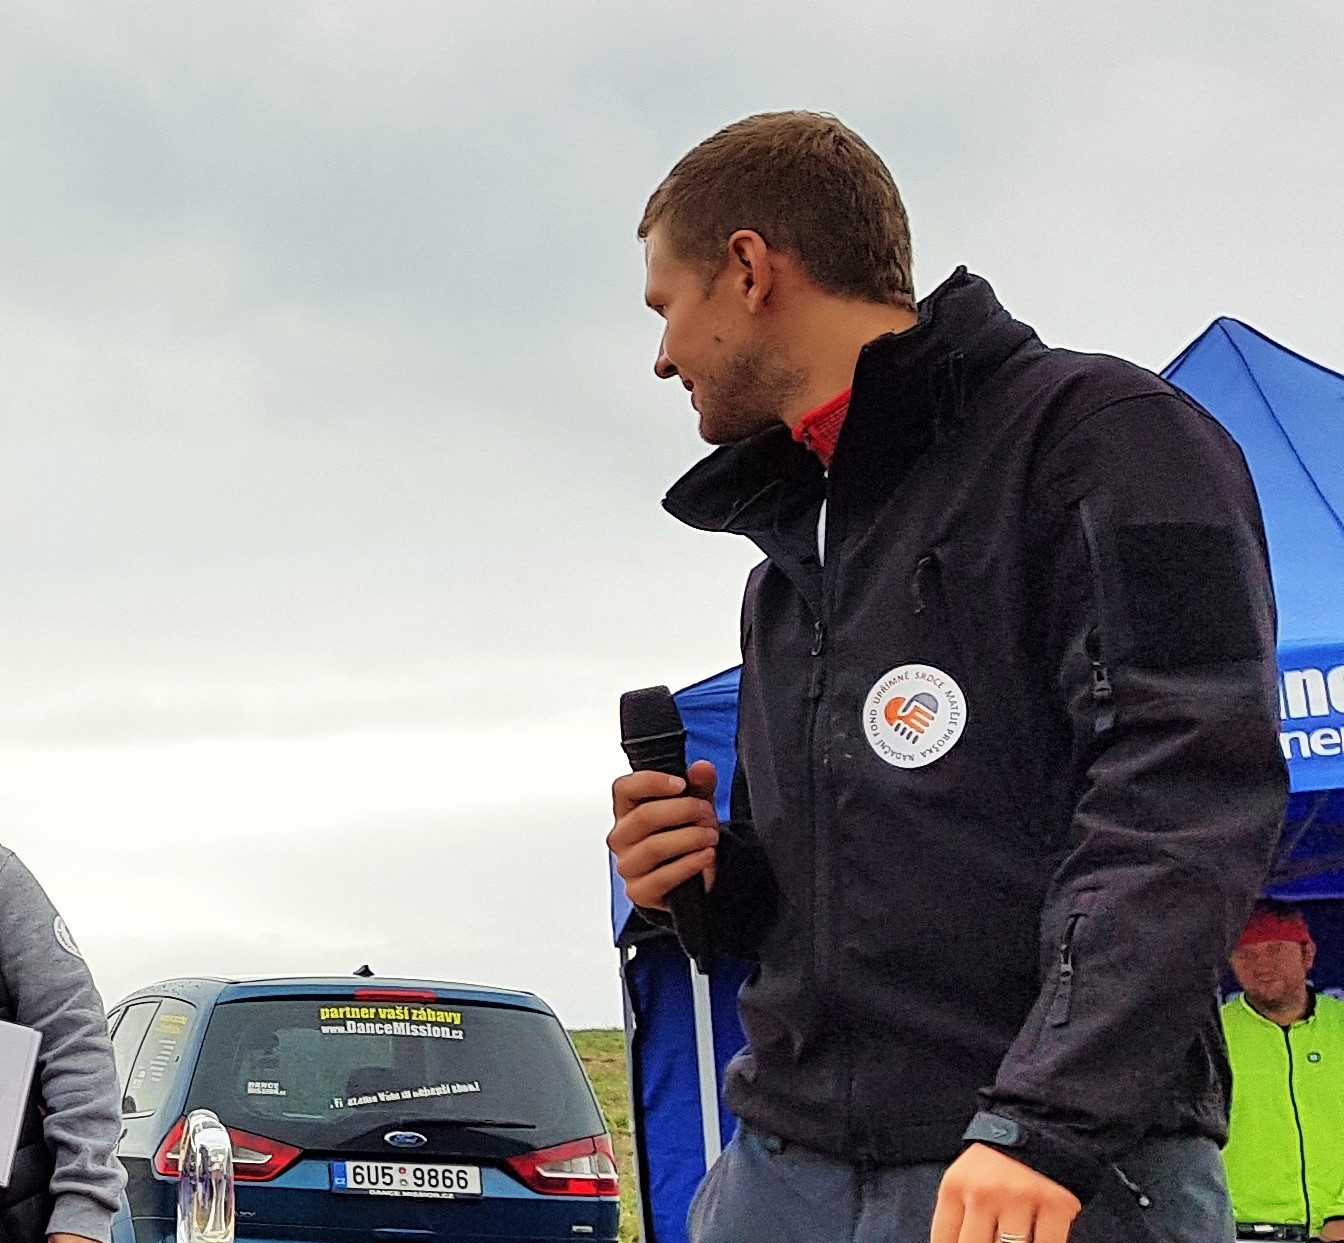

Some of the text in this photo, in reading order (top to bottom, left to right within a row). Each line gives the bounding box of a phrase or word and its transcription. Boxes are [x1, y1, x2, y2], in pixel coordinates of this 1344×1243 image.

[914, 671, 946, 690] SRDCE
[869, 709, 881, 738] FOND
[919, 728, 955, 758] PROŠKA
[319, 1005, 462, 1025] partner vaší zábavy
[321, 1021, 463, 1039] www.DanceMission.cz
[352, 1165, 469, 1190] 6U5 9866
